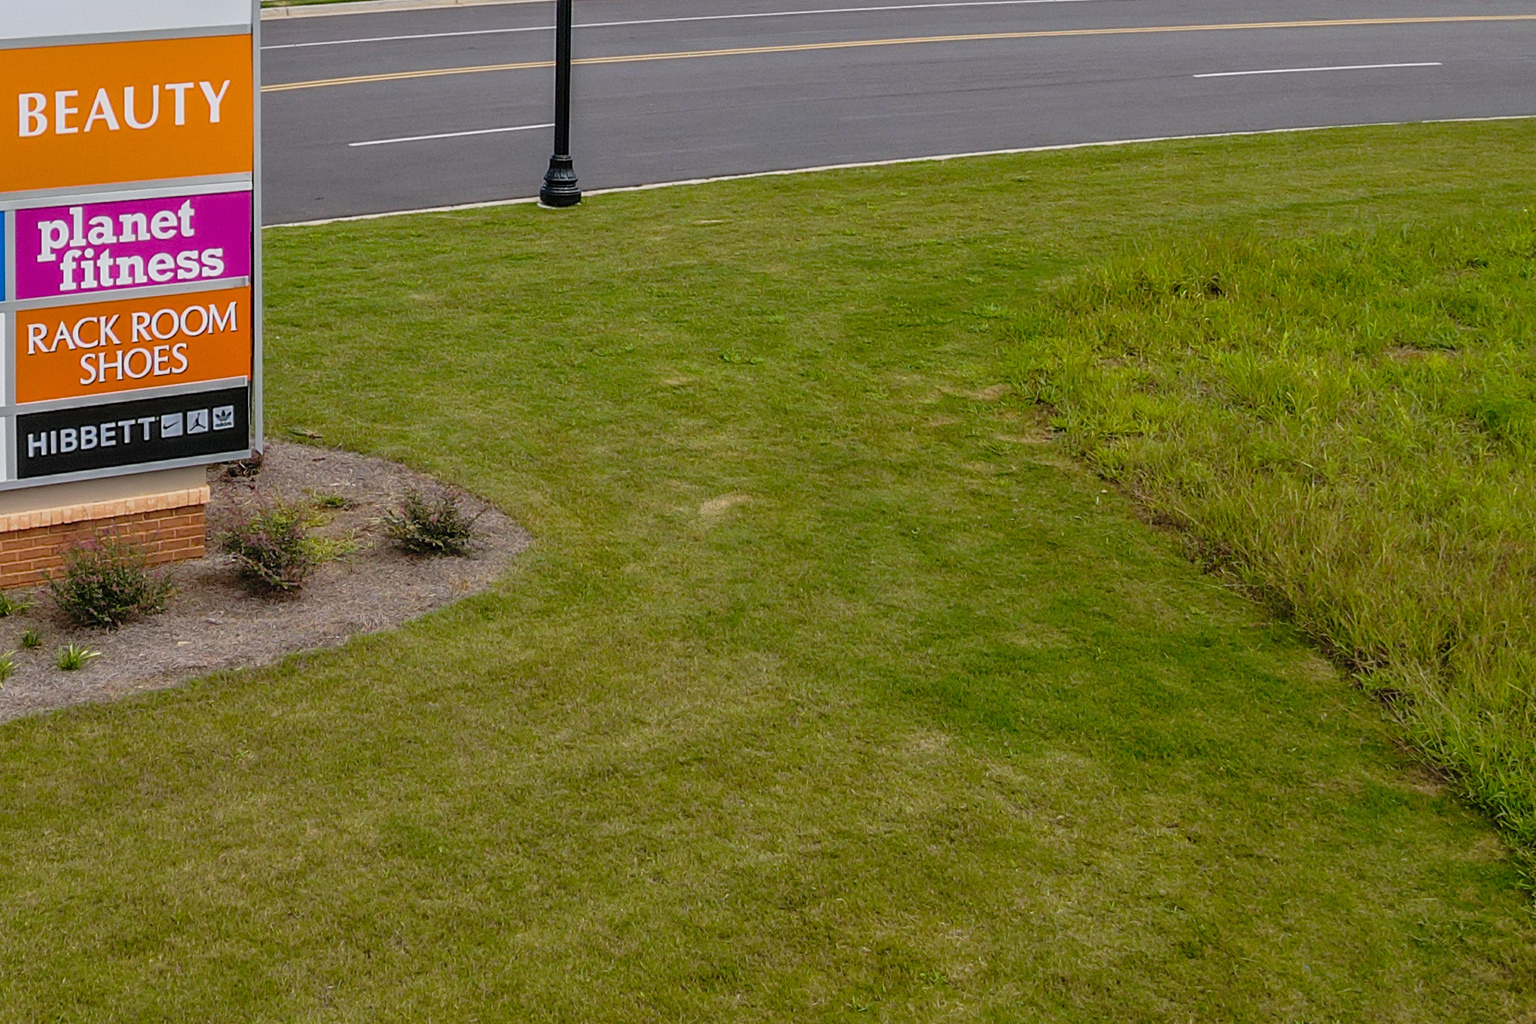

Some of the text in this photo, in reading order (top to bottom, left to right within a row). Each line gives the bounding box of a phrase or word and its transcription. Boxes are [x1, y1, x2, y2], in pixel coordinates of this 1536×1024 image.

[17, 79, 231, 138] BEAUTY
[37, 199, 195, 262] planet
[59, 247, 225, 291] fitness
[27, 301, 238, 356] RACK ROOM
[80, 343, 189, 386] SHOES
[27, 417, 157, 458] HIBBETT
